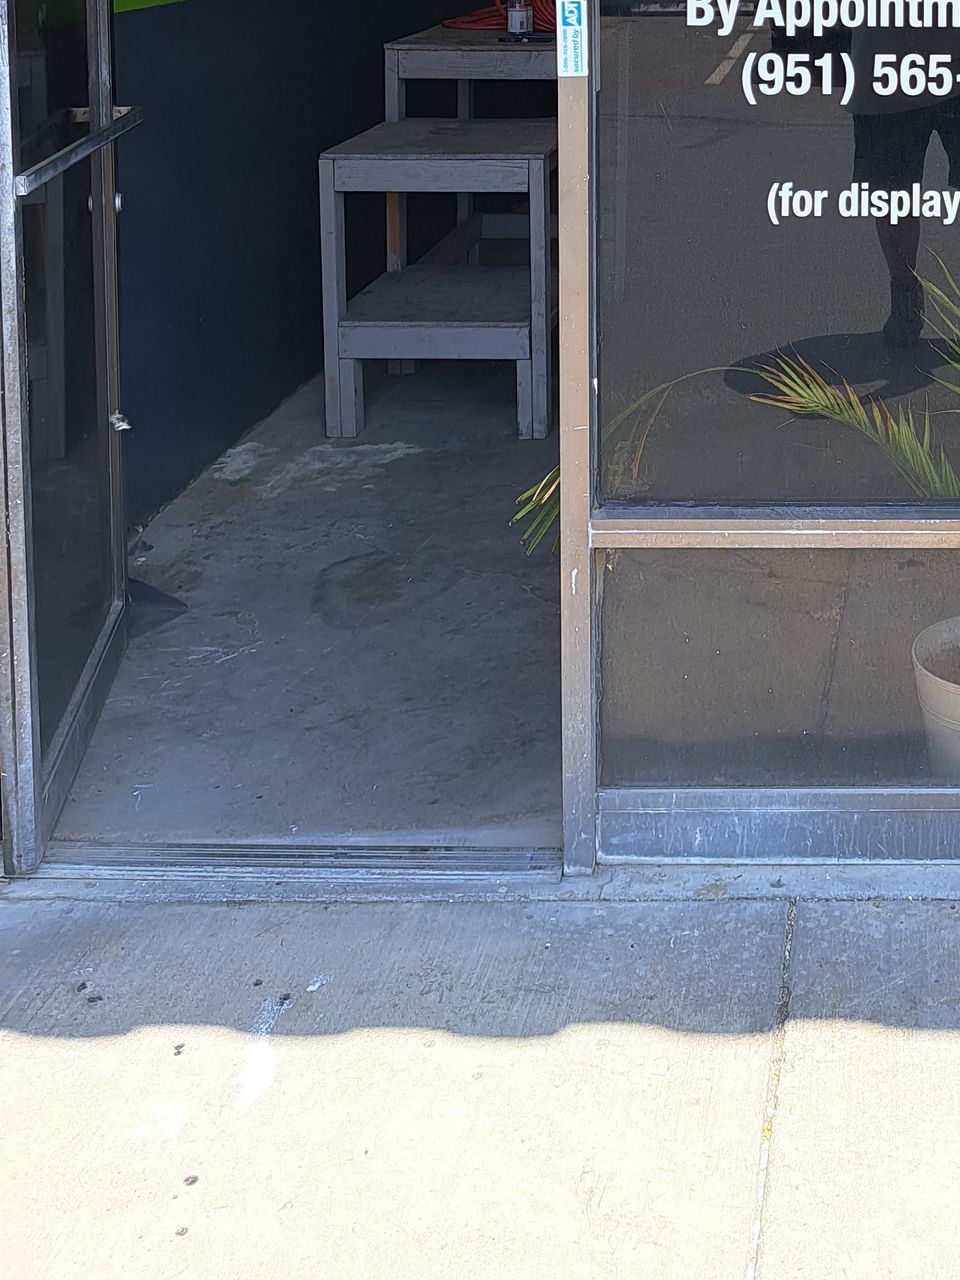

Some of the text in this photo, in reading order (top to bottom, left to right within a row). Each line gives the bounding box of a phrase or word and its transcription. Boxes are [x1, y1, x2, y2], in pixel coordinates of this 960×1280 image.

[564, 1, 579, 26] ADT
[741, 52, 856, 105] (951)
[767, 182, 829, 225] (for
